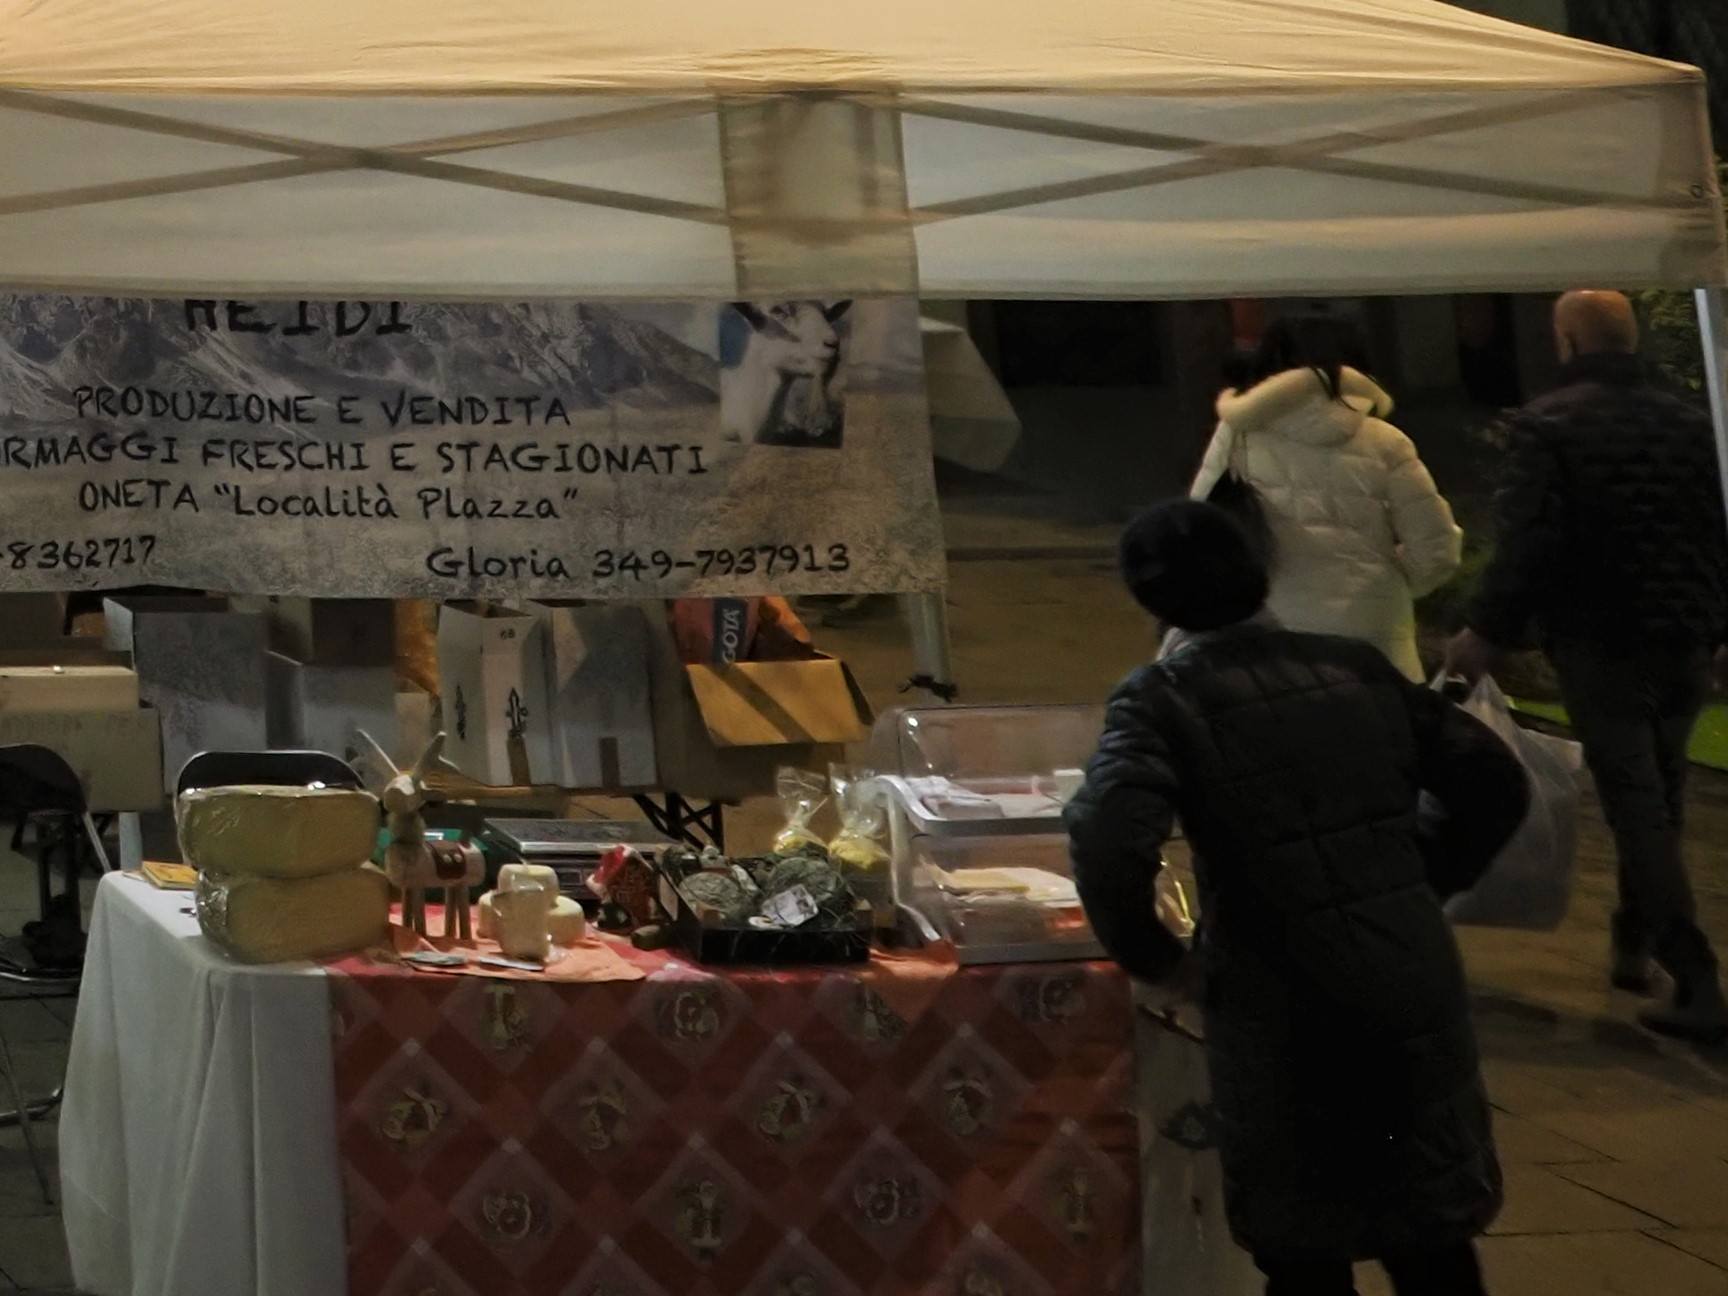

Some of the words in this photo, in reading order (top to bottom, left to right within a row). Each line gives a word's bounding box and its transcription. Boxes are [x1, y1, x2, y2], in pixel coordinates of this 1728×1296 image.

[73, 385, 316, 423] PRODUZIONE
[337, 396, 362, 424] E
[380, 390, 571, 427] VENDITA
[201, 437, 370, 470] FRESCHI
[390, 442, 416, 472] E
[436, 441, 709, 474] STAGIONATI
[79, 479, 199, 513] ONETA
[425, 546, 568, 581] Gloria
[592, 542, 851, 581] 349-7937913
